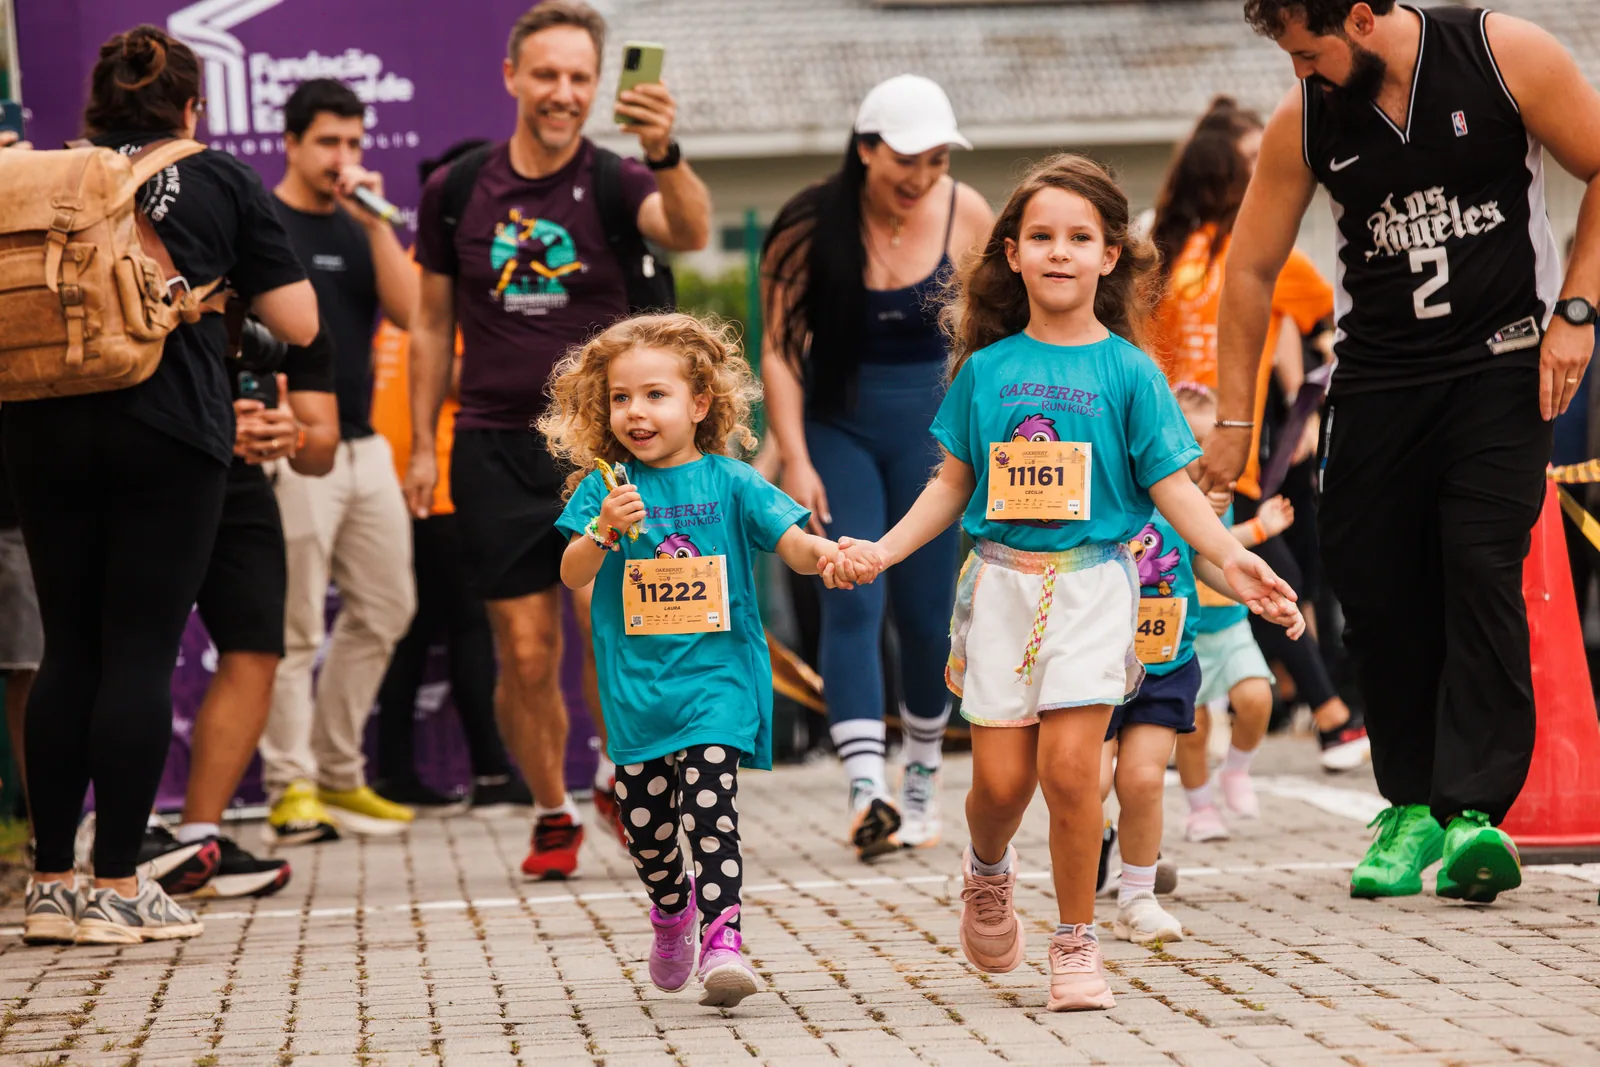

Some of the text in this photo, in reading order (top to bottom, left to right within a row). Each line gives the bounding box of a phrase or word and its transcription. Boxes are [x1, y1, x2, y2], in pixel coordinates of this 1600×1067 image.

[1380, 186, 1448, 225] Los
[1364, 196, 1505, 262] Angeles
[1409, 246, 1452, 320] 2
[1000, 383, 1099, 406] OAKBERRY
[1008, 466, 1064, 486] 11161
[645, 501, 719, 519] AKBERRY
[637, 581, 707, 602] 11222
